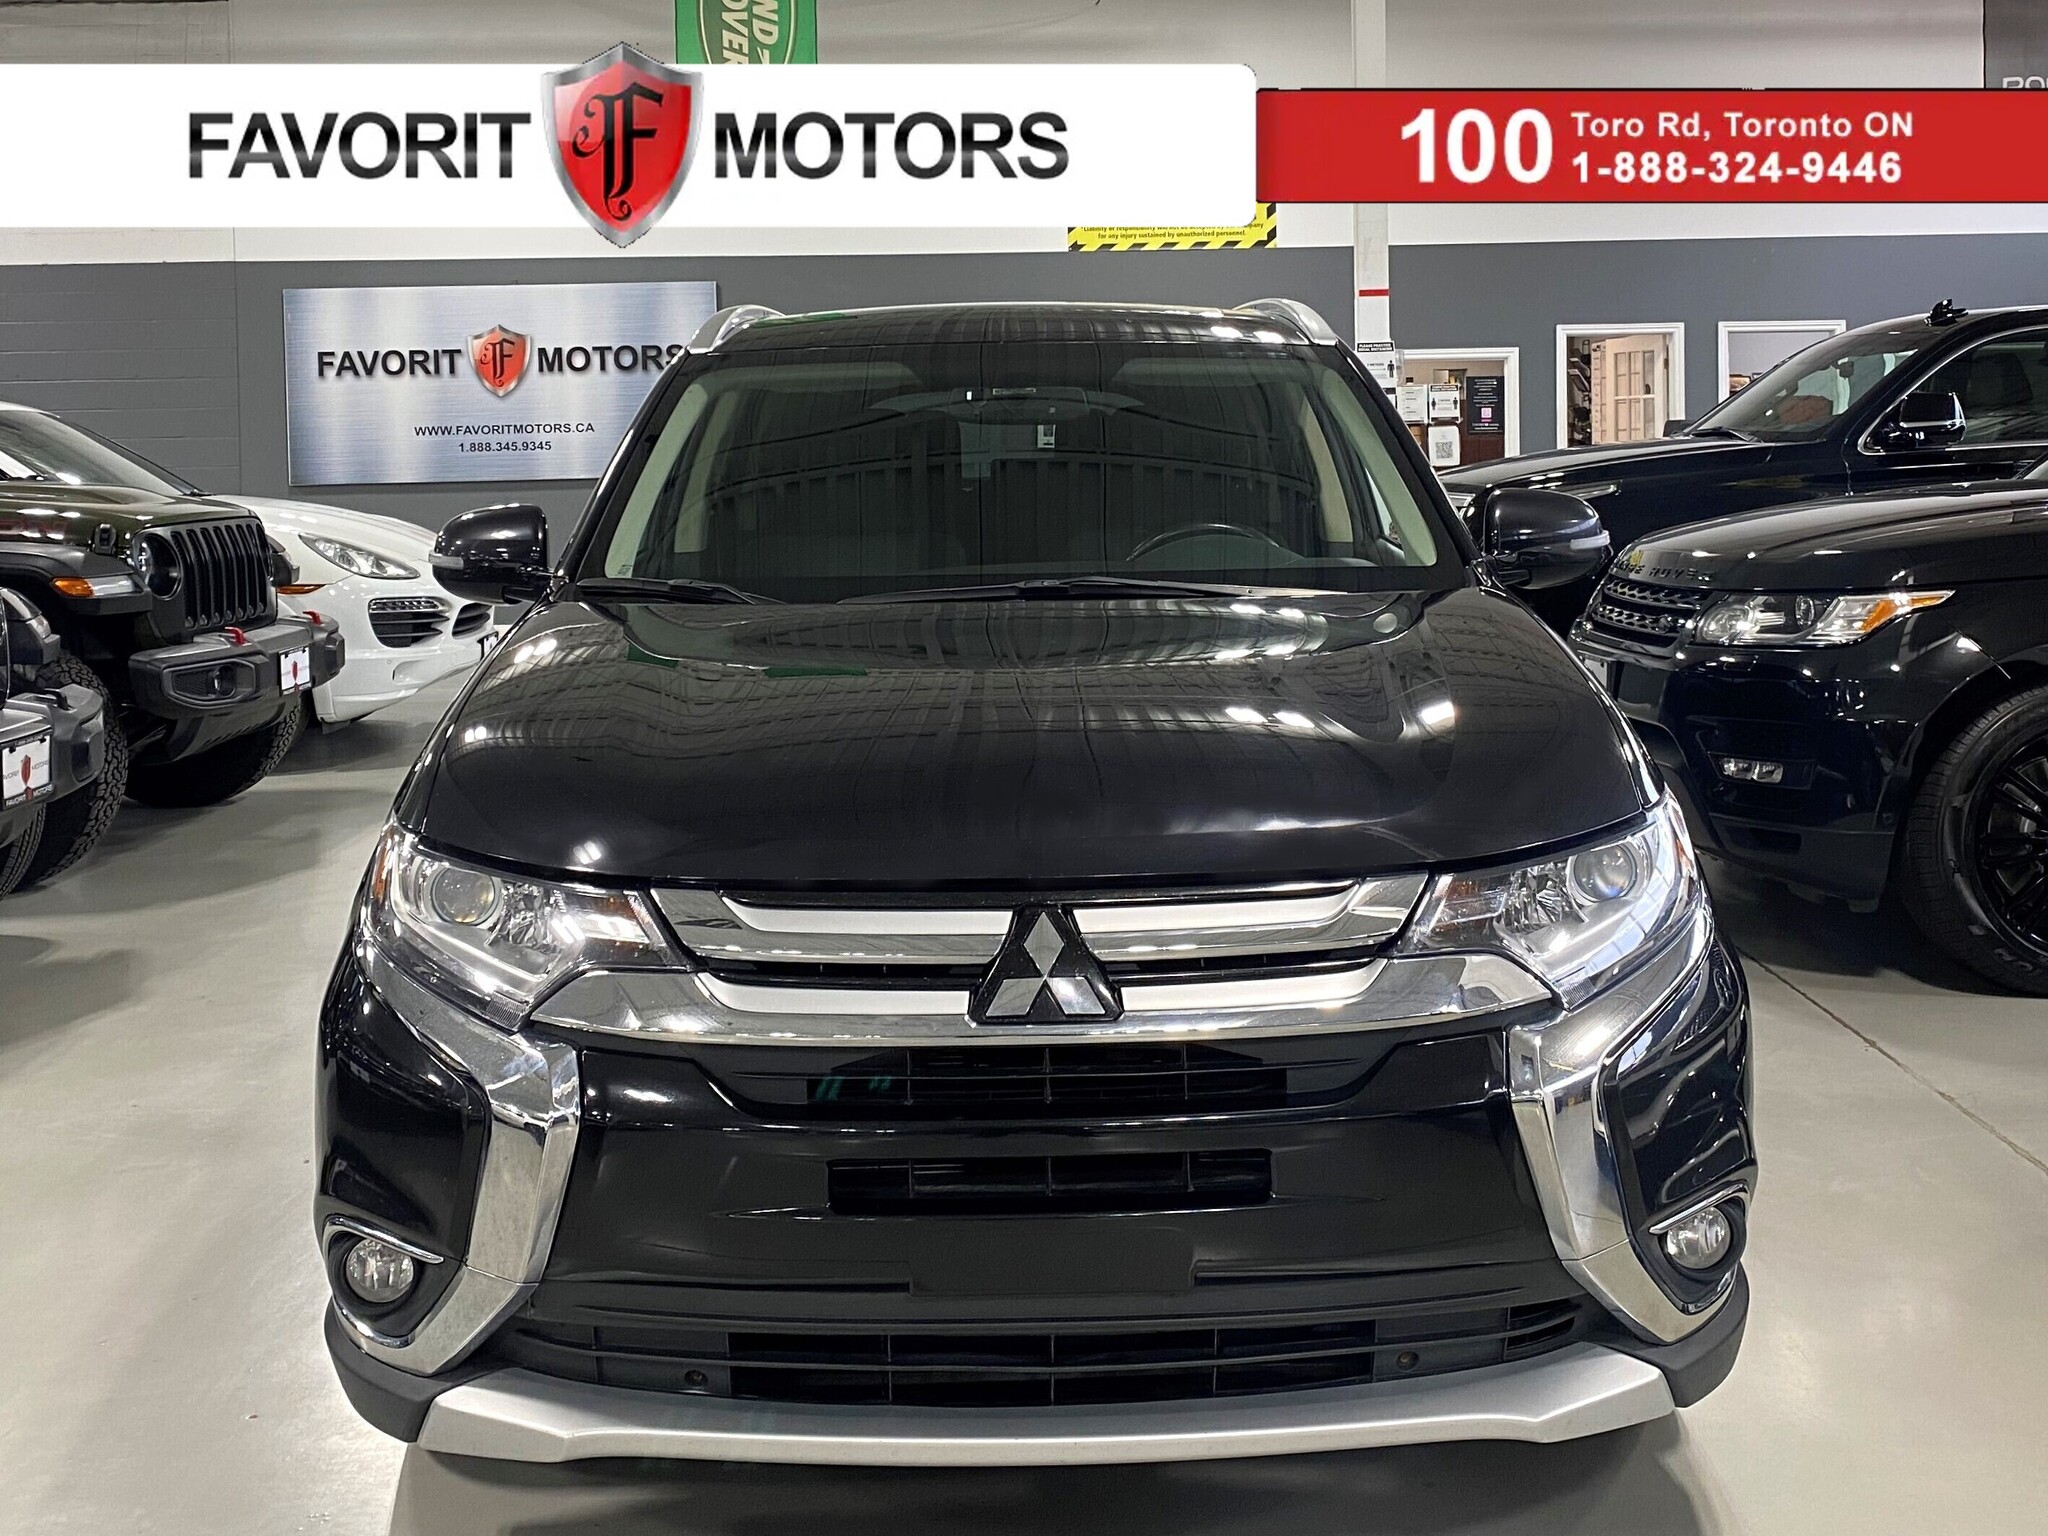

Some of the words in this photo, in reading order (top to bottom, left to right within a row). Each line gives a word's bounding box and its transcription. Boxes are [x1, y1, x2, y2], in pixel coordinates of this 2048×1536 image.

[317, 350, 461, 377] FAVORIT
[414, 423, 595, 437] WWW.FAVORITMOTORS.CA
[459, 441, 552, 453] 1.888.345.9345
